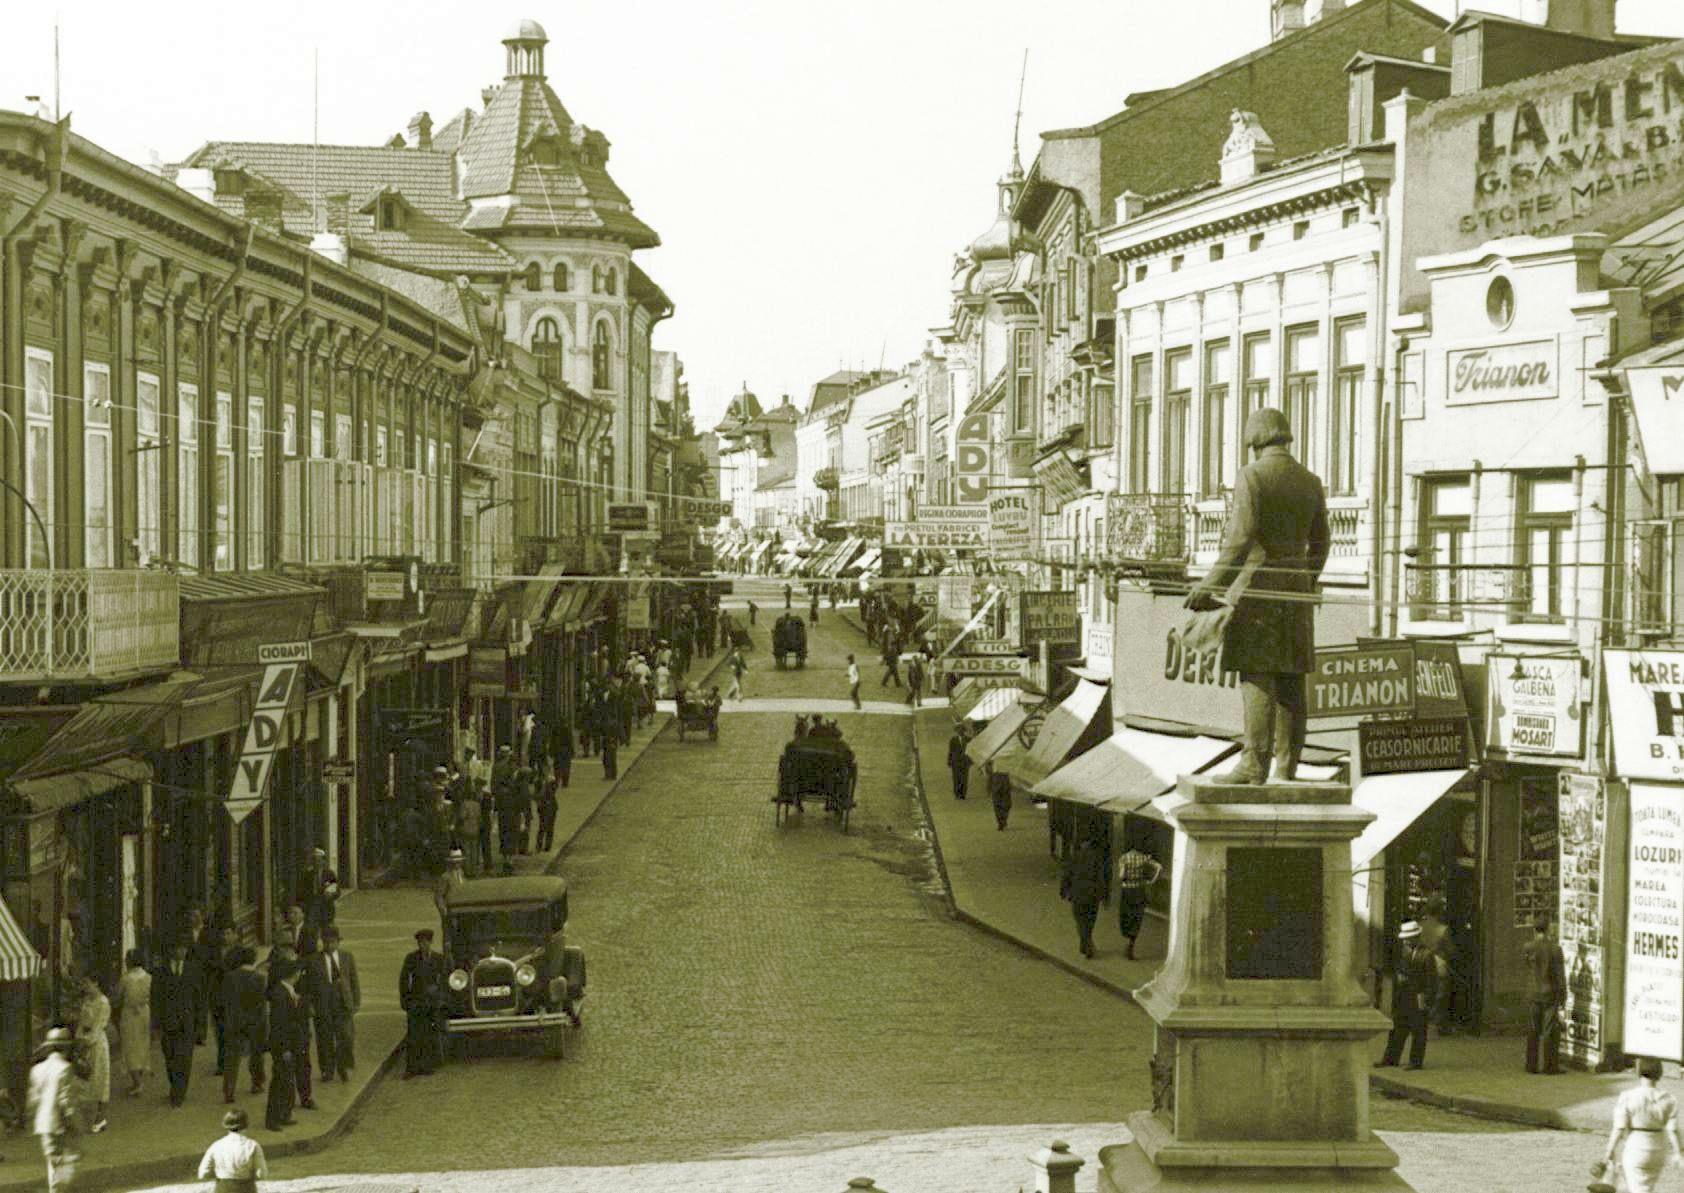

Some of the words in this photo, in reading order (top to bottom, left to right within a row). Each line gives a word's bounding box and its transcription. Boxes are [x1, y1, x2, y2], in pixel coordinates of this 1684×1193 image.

[1454, 351, 1550, 393] Trianon
[990, 496, 1029, 513] HOTEL
[891, 532, 915, 546] LA
[261, 645, 305, 659] CIORAPI
[1321, 657, 1399, 676] CINEMA
[1629, 661, 1684, 686] MARE
[1315, 677, 1409, 709] TRIANON
[240, 666, 295, 793] ADY
[1511, 727, 1553, 748] MOSART
[1365, 735, 1462, 759] CEASORNICARIE
[1634, 845, 1682, 864] LOZURI
[1633, 931, 1679, 960] HERMES
